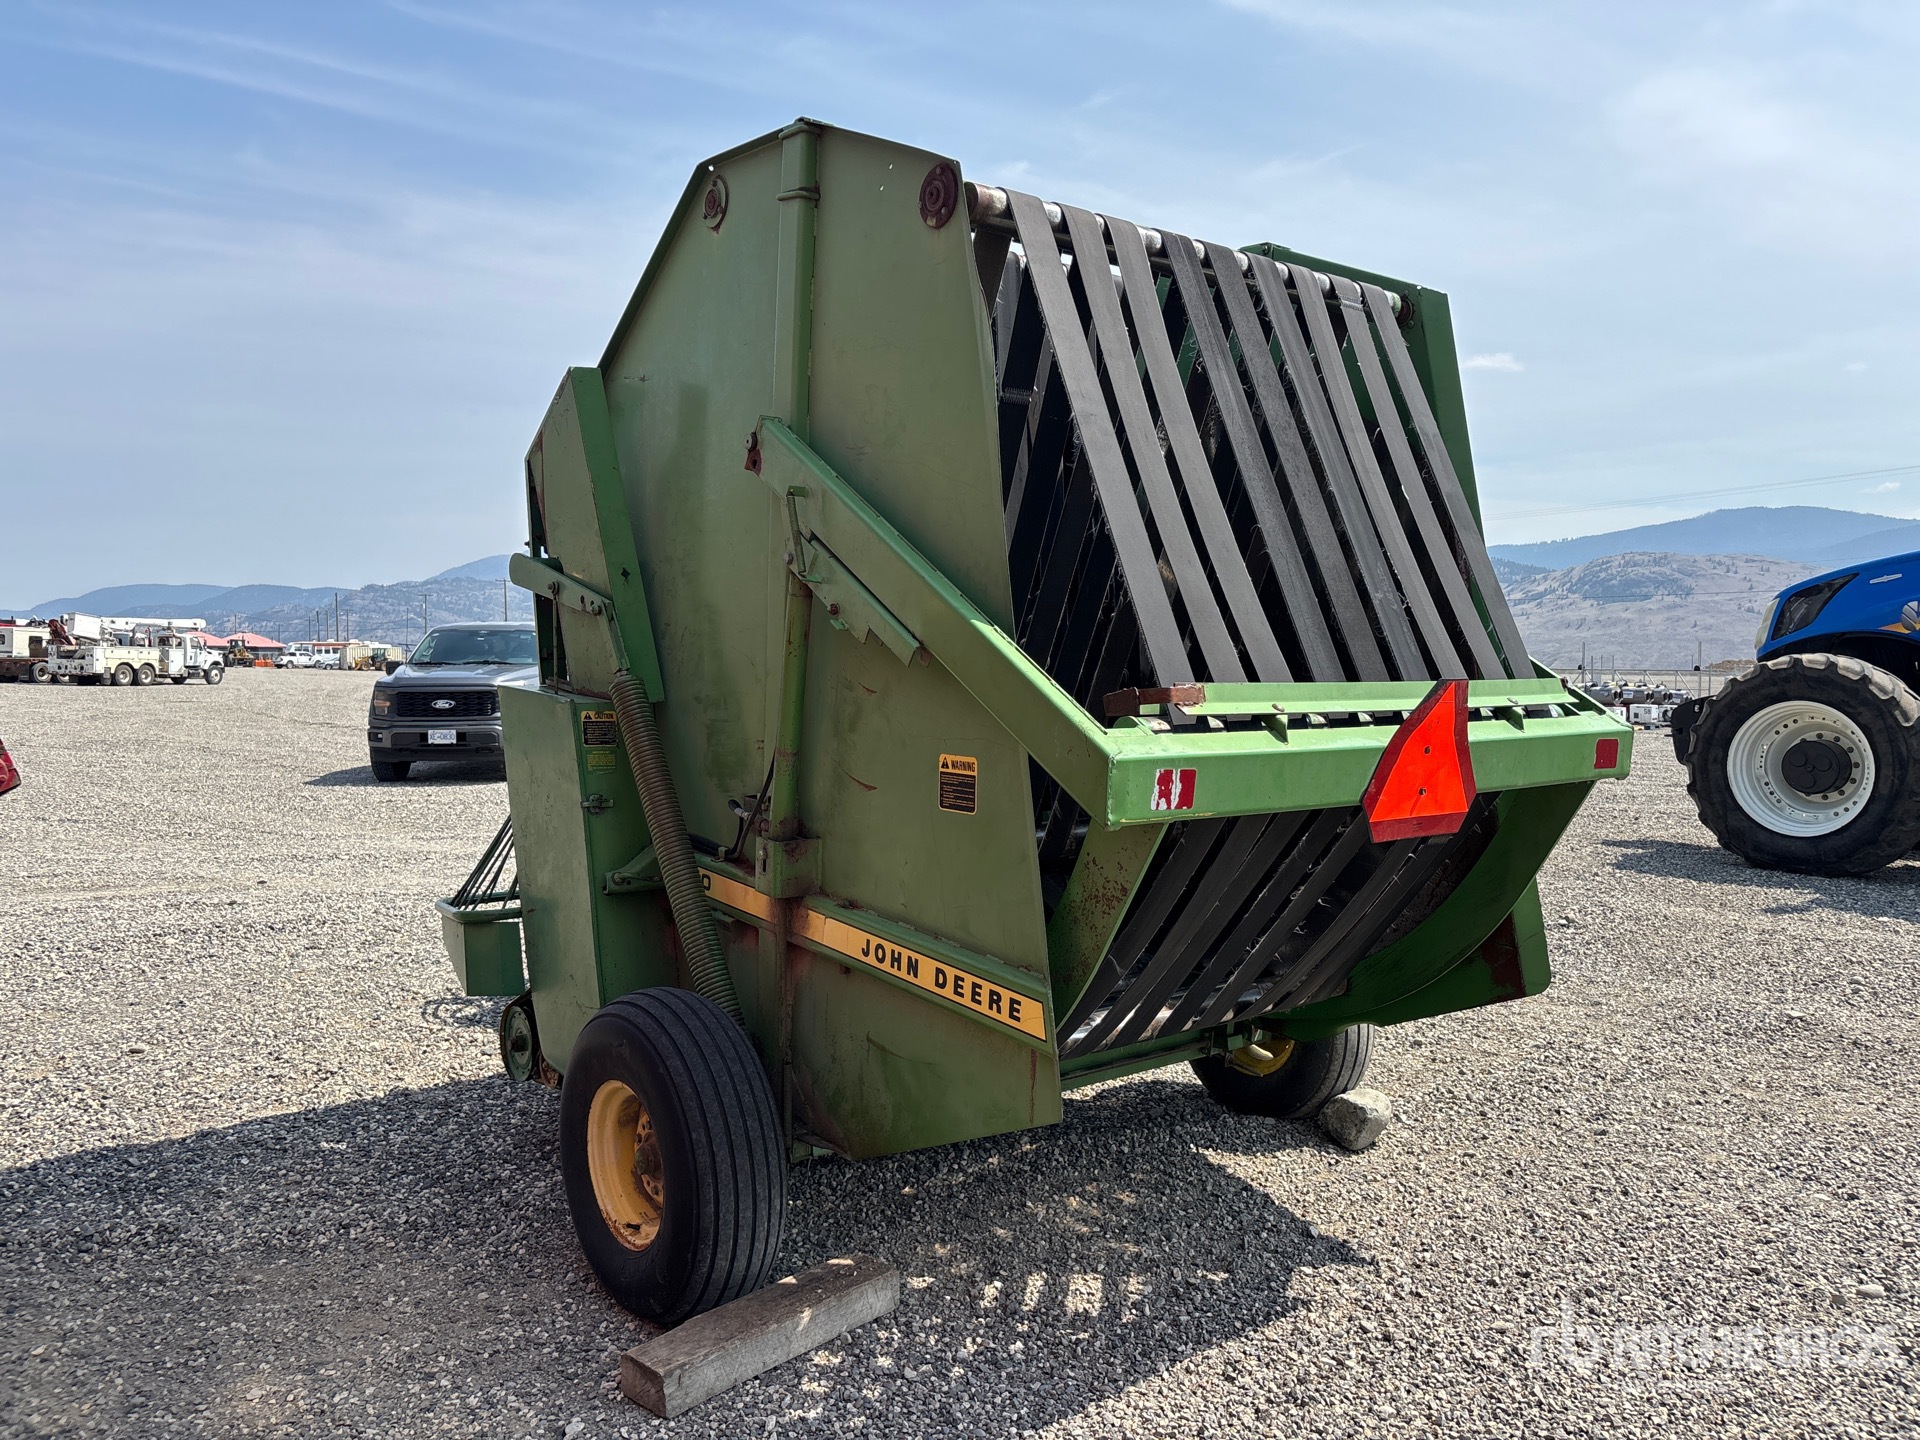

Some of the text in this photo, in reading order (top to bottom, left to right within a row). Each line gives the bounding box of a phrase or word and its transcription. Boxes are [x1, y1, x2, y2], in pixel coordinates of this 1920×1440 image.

[594, 712, 614, 720] CAUTION
[951, 759, 976, 773] WARNING
[861, 938, 1022, 1023] JOHN DEERE
